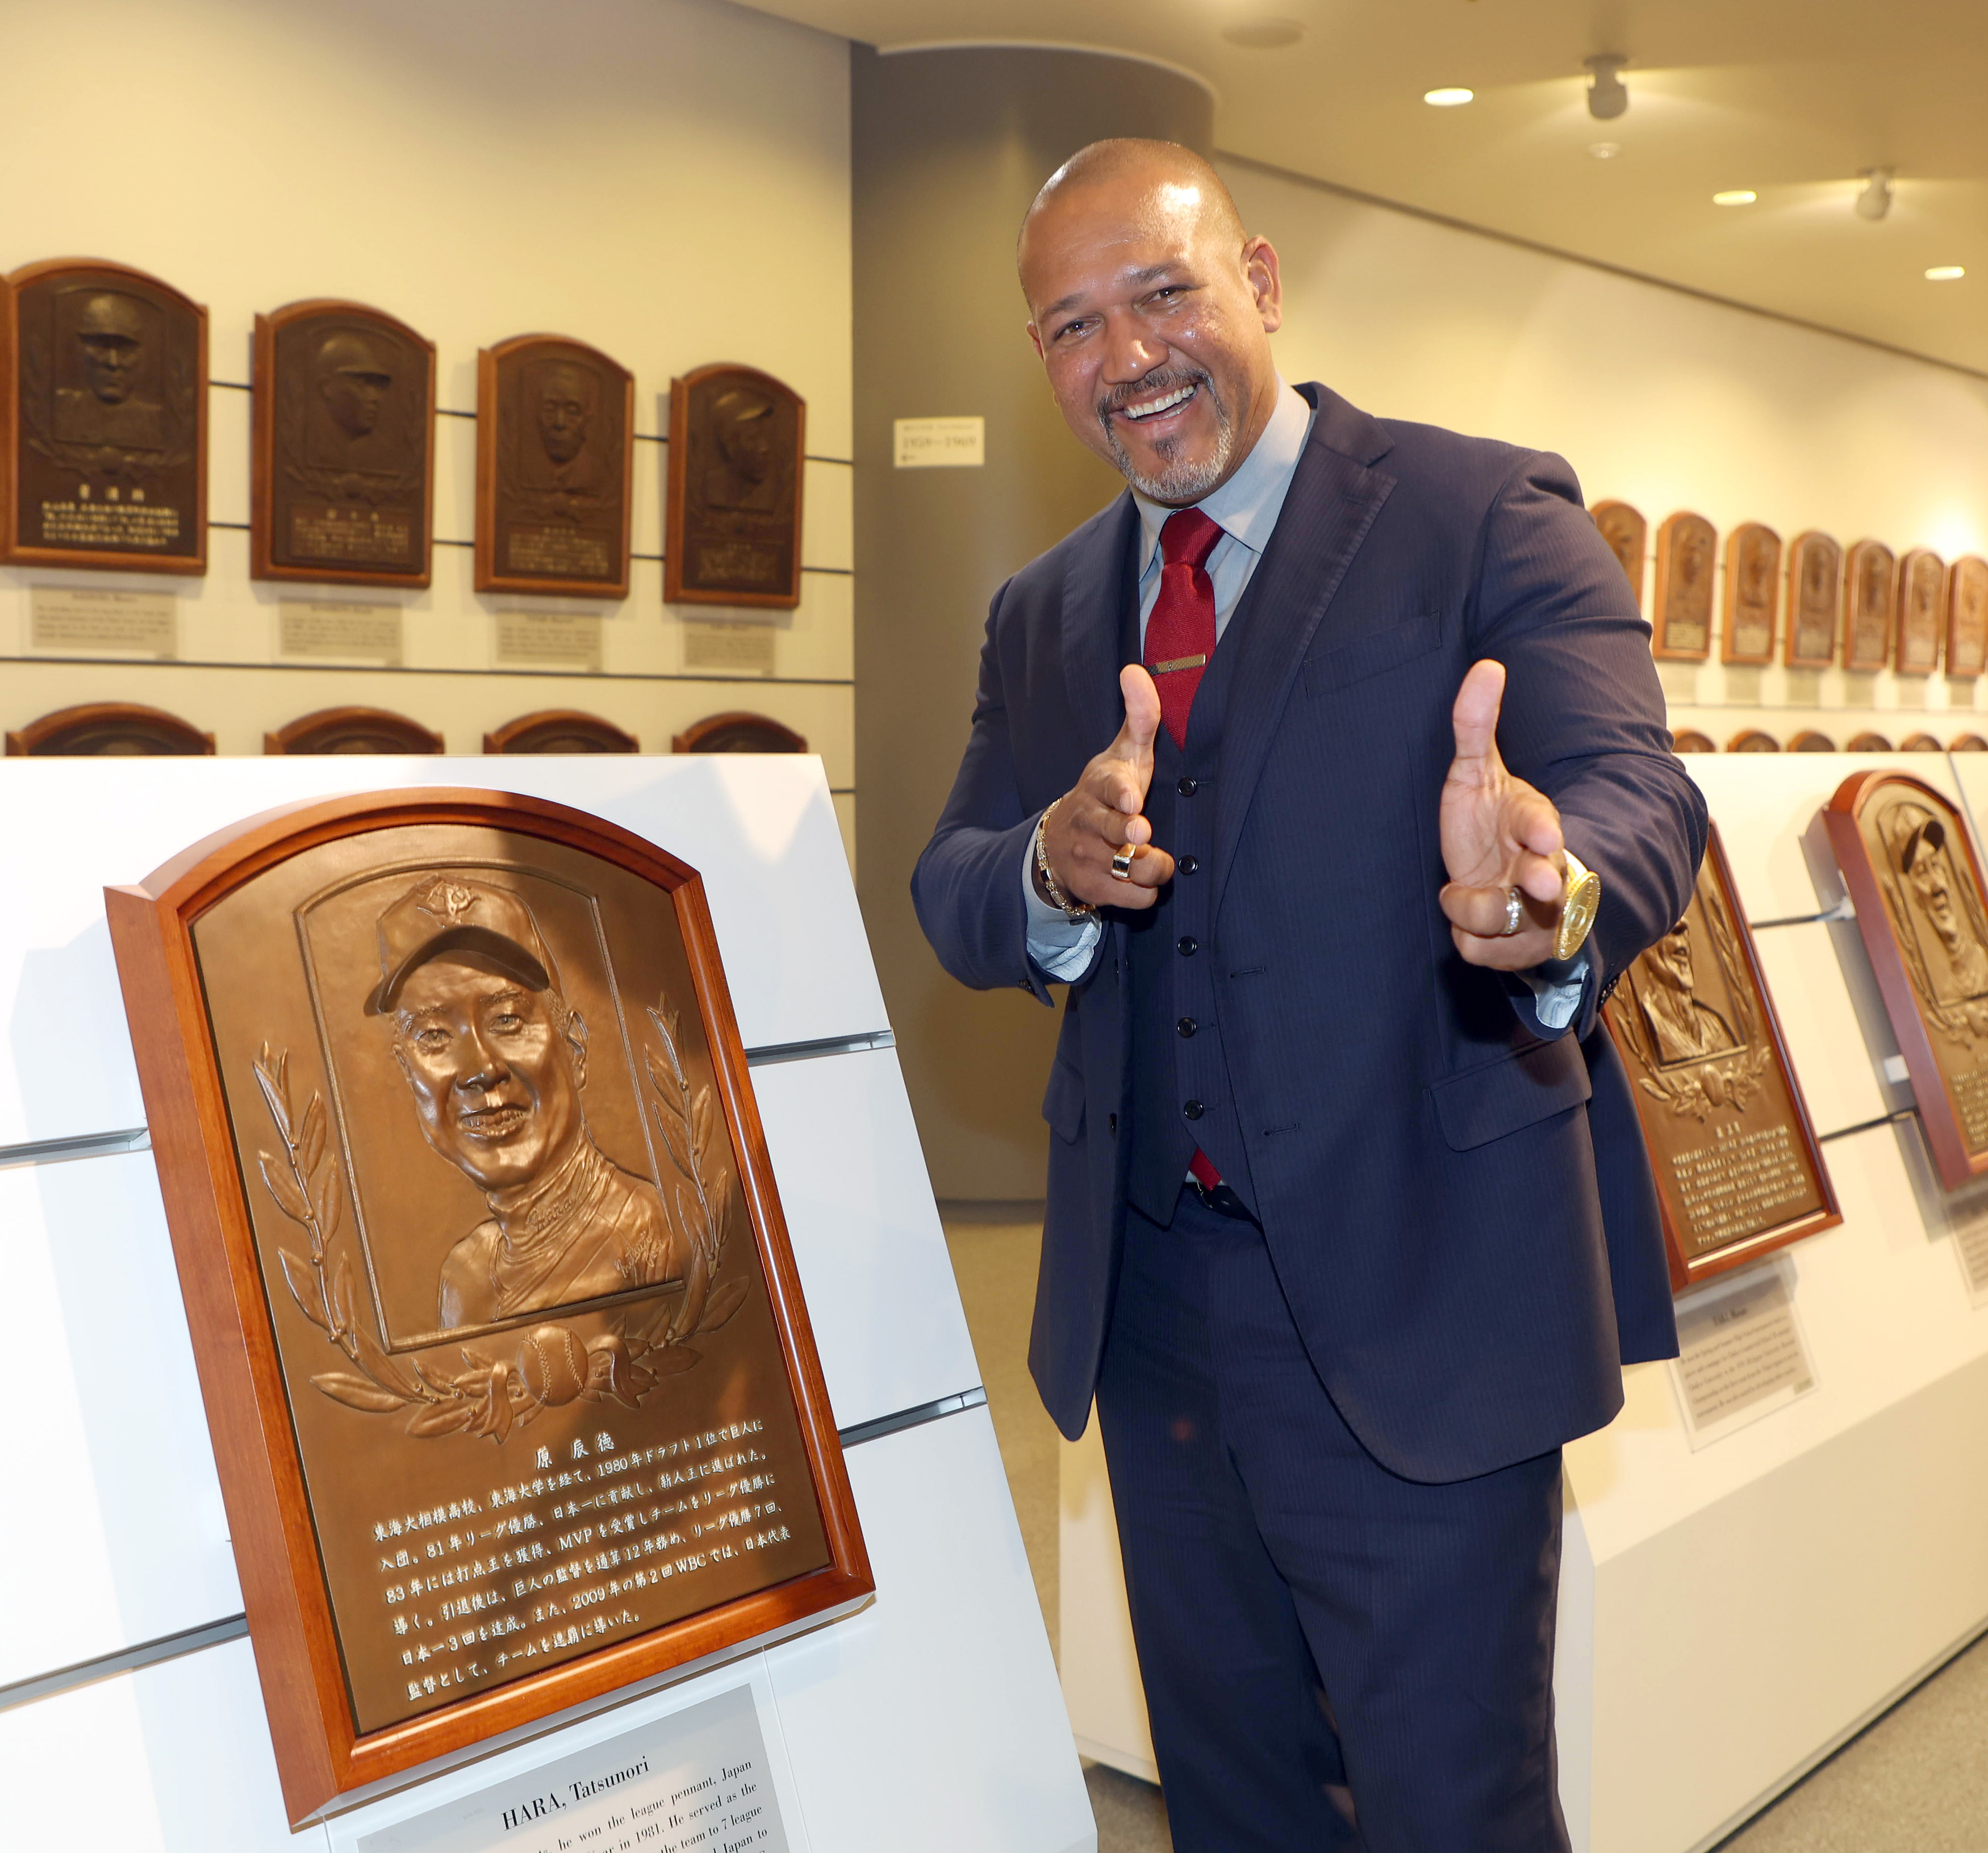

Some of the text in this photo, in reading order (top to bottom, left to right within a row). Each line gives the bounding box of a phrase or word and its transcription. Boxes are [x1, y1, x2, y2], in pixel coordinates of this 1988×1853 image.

[535, 1431, 615, 1470] 原 辰徳
[500, 1755, 650, 1831] HARA, Tatsunori
[558, 1760, 752, 1851] he won the league pennant, Japan
[619, 1839, 631, 1851] in
[636, 1823, 665, 1843] 1981.
[669, 1815, 684, 1829] He
[688, 1796, 722, 1821] served
[726, 1792, 737, 1804] as
[741, 1783, 757, 1797] the
[680, 1831, 707, 1850] team
[709, 1826, 719, 1837] to
[721, 1818, 728, 1830] 7
[730, 1806, 763, 1826] league
[723, 1835, 753, 1853] Japan
[757, 1829, 768, 1839] to
